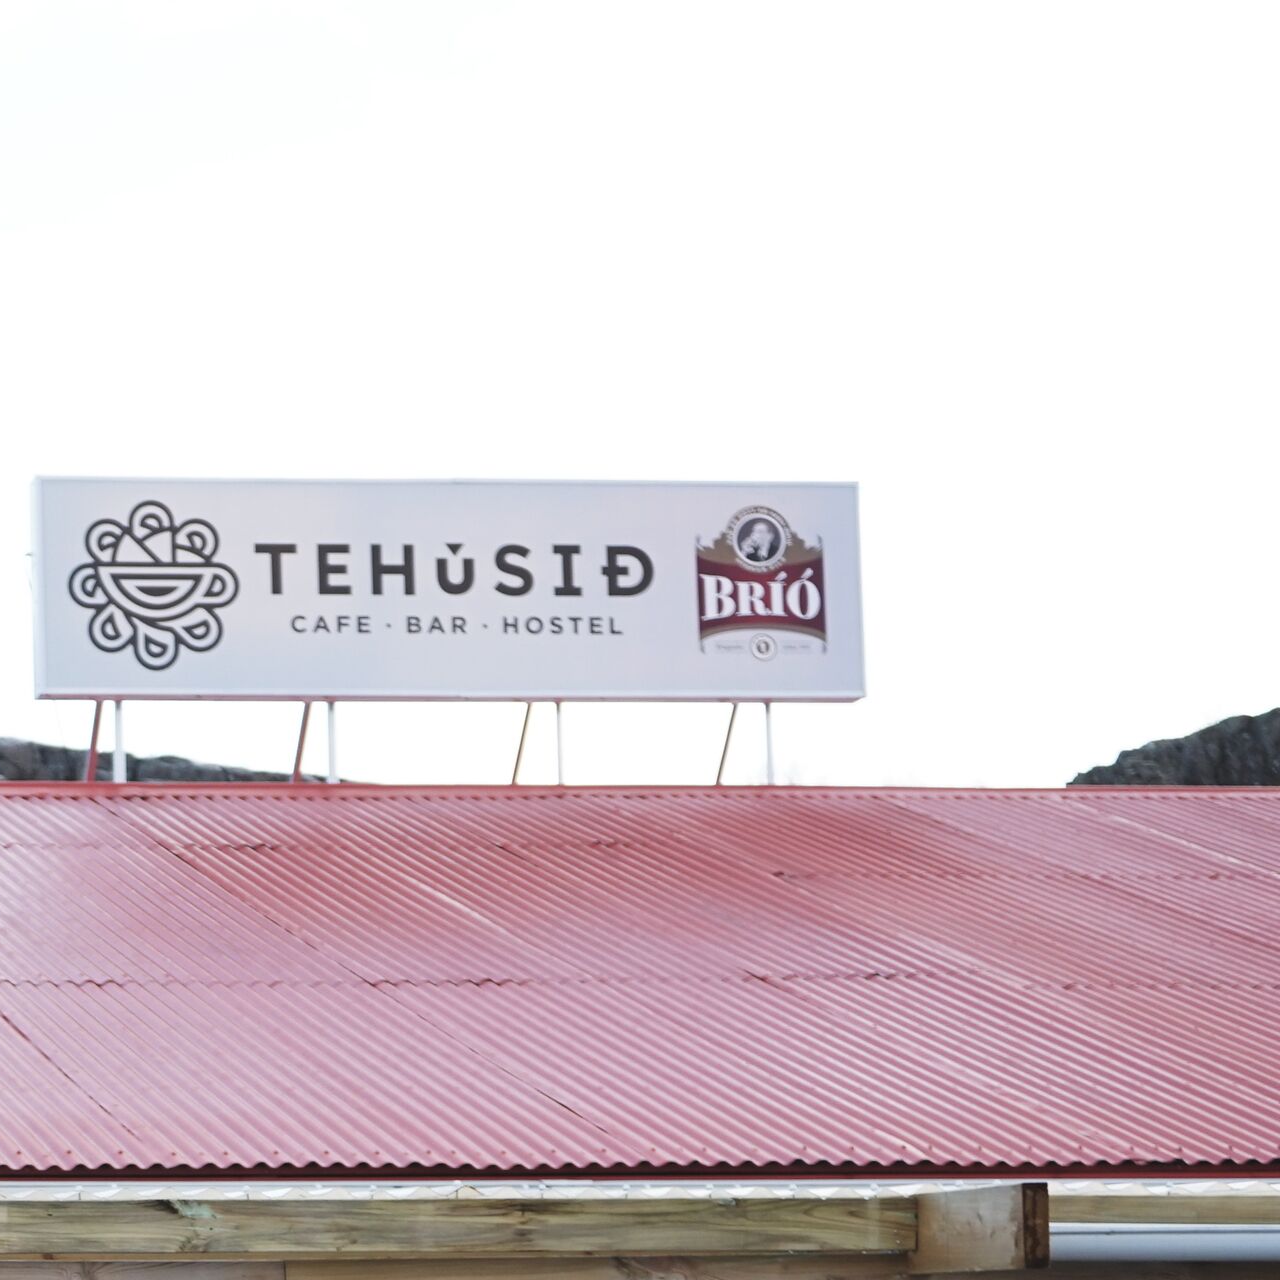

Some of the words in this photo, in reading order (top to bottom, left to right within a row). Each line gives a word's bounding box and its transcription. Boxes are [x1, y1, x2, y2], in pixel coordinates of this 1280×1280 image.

[290, 615, 371, 633] CAFE
[407, 616, 467, 633] BAR
[503, 616, 623, 635] HOSTEL
